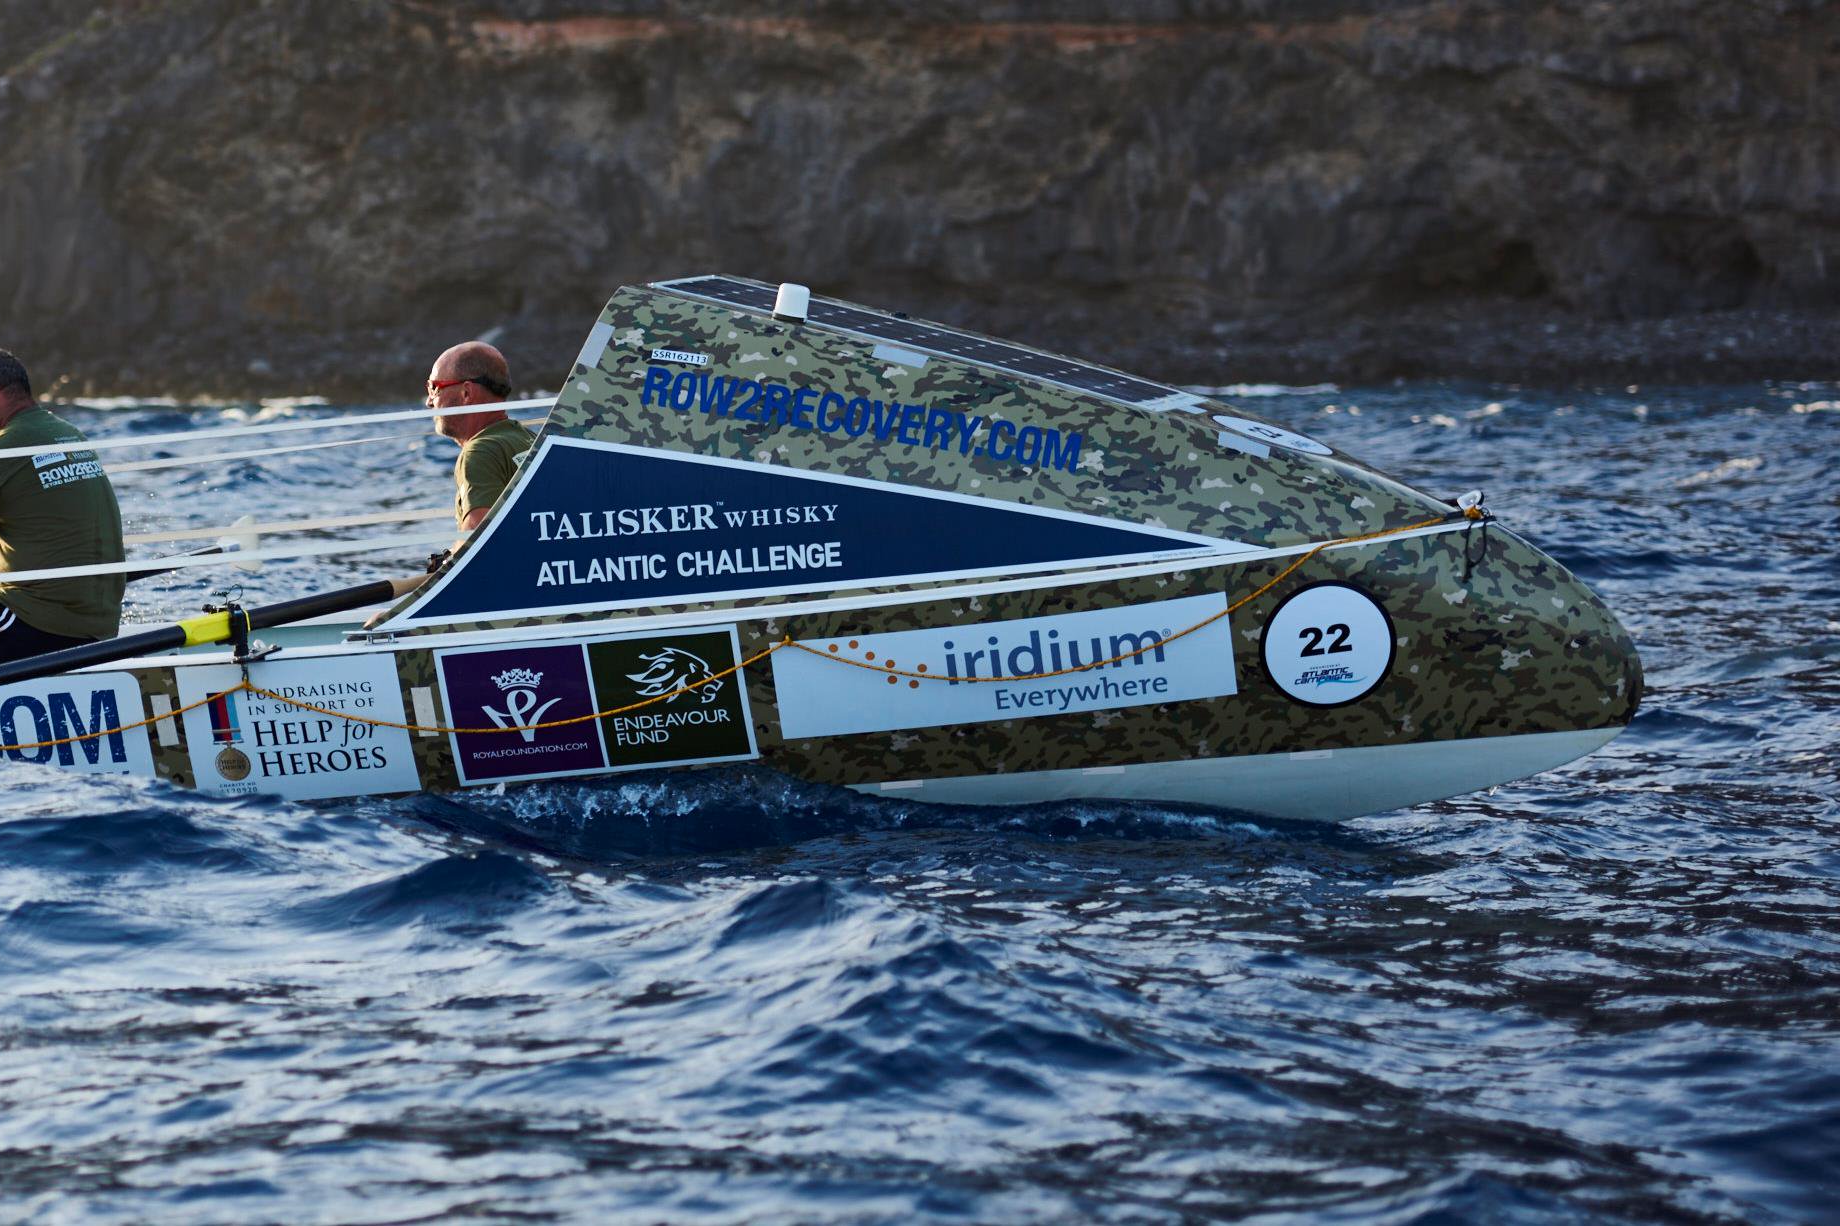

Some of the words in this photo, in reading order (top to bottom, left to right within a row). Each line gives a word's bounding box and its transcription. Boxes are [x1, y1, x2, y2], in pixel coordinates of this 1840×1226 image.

[652, 350, 707, 364] SSR162113
[641, 366, 1083, 474] ROW2RECOVERY.COM
[531, 504, 718, 541] TALISKER
[724, 504, 839, 528] WHISKY
[536, 554, 667, 587] ATLANTIC
[676, 542, 843, 577] CHALLENGE
[1299, 623, 1353, 658] 22
[246, 681, 373, 700] FUNDRAISING
[995, 677, 1168, 710] Everywhere
[248, 706, 265, 715] IN
[274, 698, 346, 714] SUPPORT
[354, 697, 374, 708] OF
[613, 708, 730, 732] ENDEAVOUR
[251, 719, 333, 747] HELP
[341, 718, 377, 747] for
[617, 729, 669, 746] FUND
[260, 746, 387, 777] HEROES
[473, 742, 588, 759] ROYALFOUNDATION.COM
